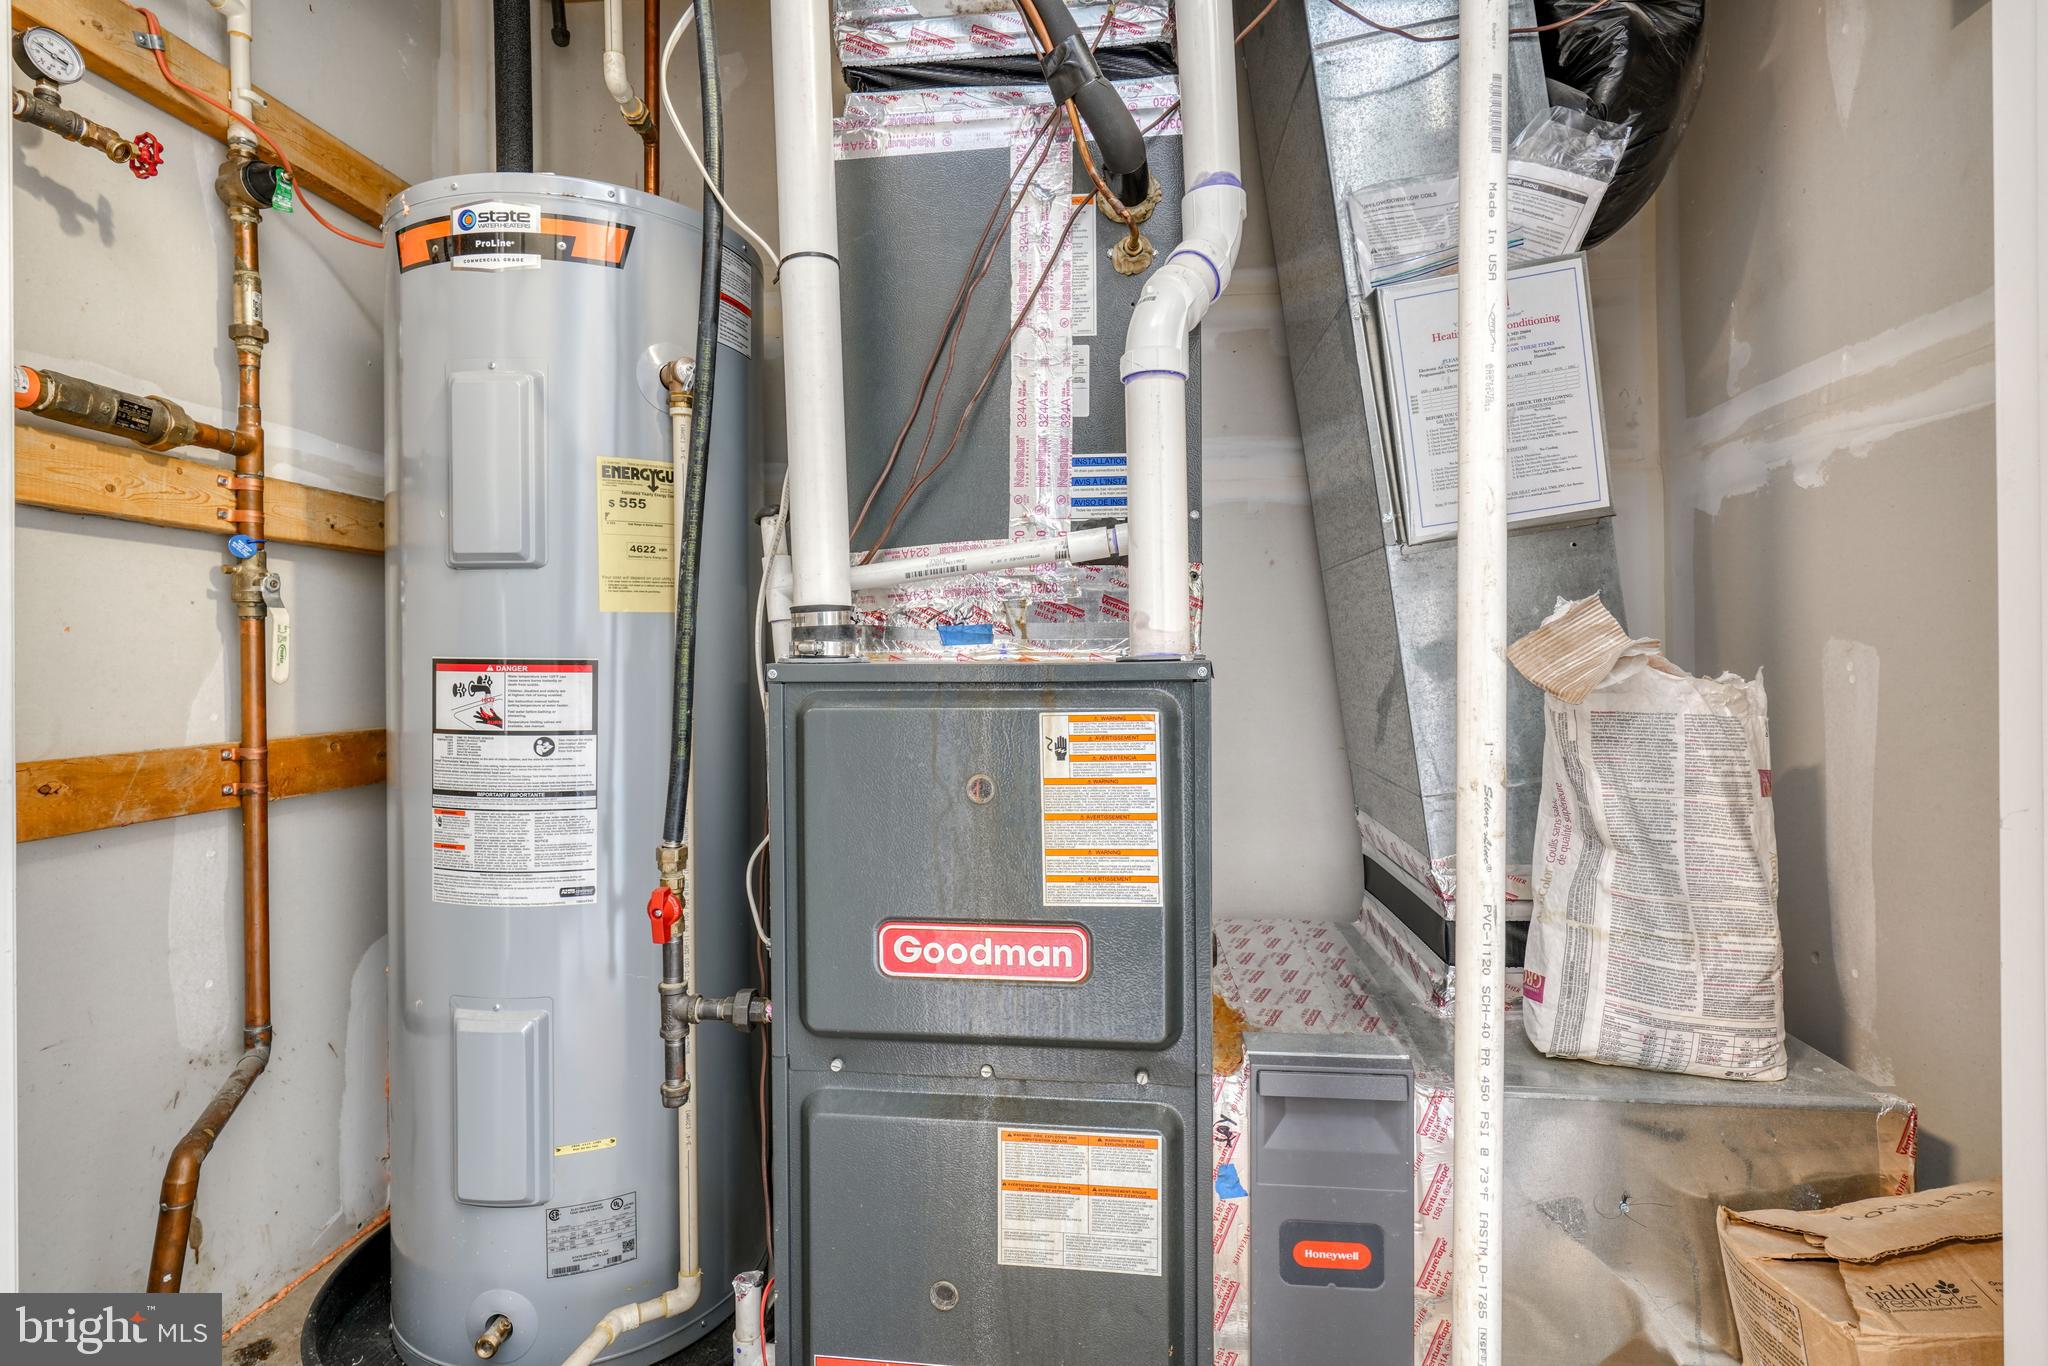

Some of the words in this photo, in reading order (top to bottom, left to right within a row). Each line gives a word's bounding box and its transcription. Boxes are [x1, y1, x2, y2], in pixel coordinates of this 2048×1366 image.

[845, 34, 889, 57] VentureTape
[911, 29, 956, 50] VentureTape
[969, 36, 989, 48] 1581A
[972, 26, 1016, 48] VentureTape
[850, 139, 878, 150] 324A
[887, 137, 935, 149] Nashua
[1488, 183, 1497, 218] Made
[478, 210, 531, 223] state
[1019, 222, 1029, 253] 324A
[1488, 229, 1497, 245] In
[1488, 255, 1497, 281] USA
[1060, 260, 1071, 311] Nashua
[1432, 326, 1459, 343] Heati
[1506, 313, 1560, 330] onditioning
[1016, 398, 1027, 428] 324A
[1038, 398, 1049, 428] 324A
[1060, 398, 1071, 428] 324A
[1014, 436, 1026, 488] Nashua
[1035, 436, 1047, 488] Nashua
[1057, 436, 1069, 488] Nashua
[1075, 457, 1127, 465] INSTALLATION
[601, 465, 674, 484] ENERGYGU
[1100, 477, 1127, 485] L'INSTA
[608, 499, 615, 508] $
[619, 497, 647, 509] 555
[630, 545, 656, 554] 4622
[901, 547, 929, 560] 324A
[1036, 603, 1057, 615] 181A-P
[1043, 601, 1086, 619] entureTape
[1102, 598, 1129, 613] Venture
[1555, 782, 1572, 822] supérieure
[1552, 818, 1561, 837] sans
[1561, 825, 1572, 852] qualité
[1546, 839, 1559, 863] Coulis
[1557, 855, 1567, 865] de
[893, 935, 1072, 968] Goodman
[1481, 904, 1493, 977] PVC-1120
[1481, 986, 1491, 1039] SCH-40
[1481, 1048, 1490, 1068] PR
[1480, 1076, 1490, 1102] 450
[1480, 1111, 1489, 1137] PSI
[1420, 1163, 1450, 1216] VentureTape
[1432, 1197, 1449, 1221] 1581A
[1213, 1201, 1236, 1254] VentureTap
[1304, 1249, 1359, 1261] Honeywell
[1419, 1237, 1448, 1291] VentureTape
[1427, 1270, 1442, 1294] 181A-P
[1435, 1270, 1453, 1297] 181B-FX
[1478, 1265, 1488, 1320] D-1785
[1213, 1278, 1238, 1331] VentureTap
[1875, 1295, 1979, 1314] greenworks
[1426, 1320, 1452, 1366] entureTape
